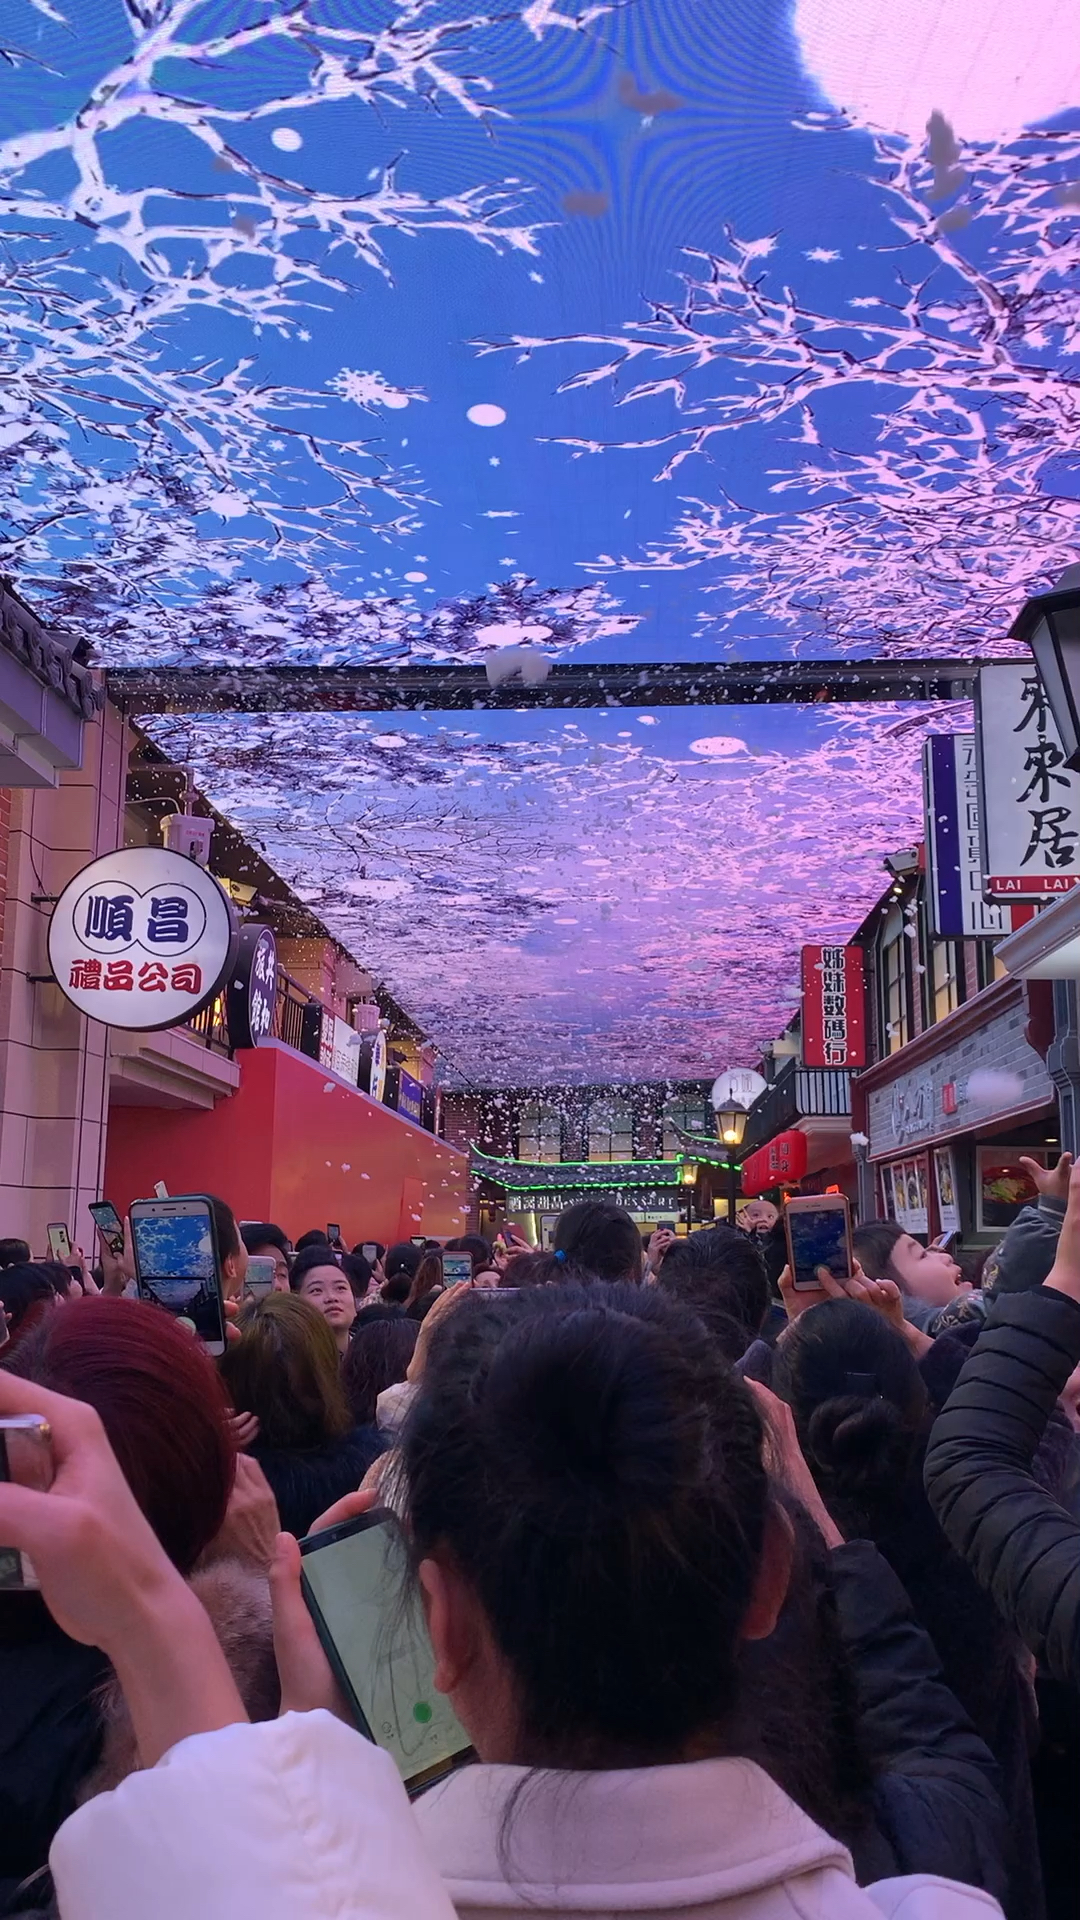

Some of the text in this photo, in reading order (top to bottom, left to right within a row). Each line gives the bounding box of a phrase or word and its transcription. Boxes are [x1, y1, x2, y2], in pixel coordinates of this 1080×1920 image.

[996, 878, 1069, 891] LAI LAI
[85, 895, 189, 943] 順昌
[69, 958, 202, 995] 禮品公司
